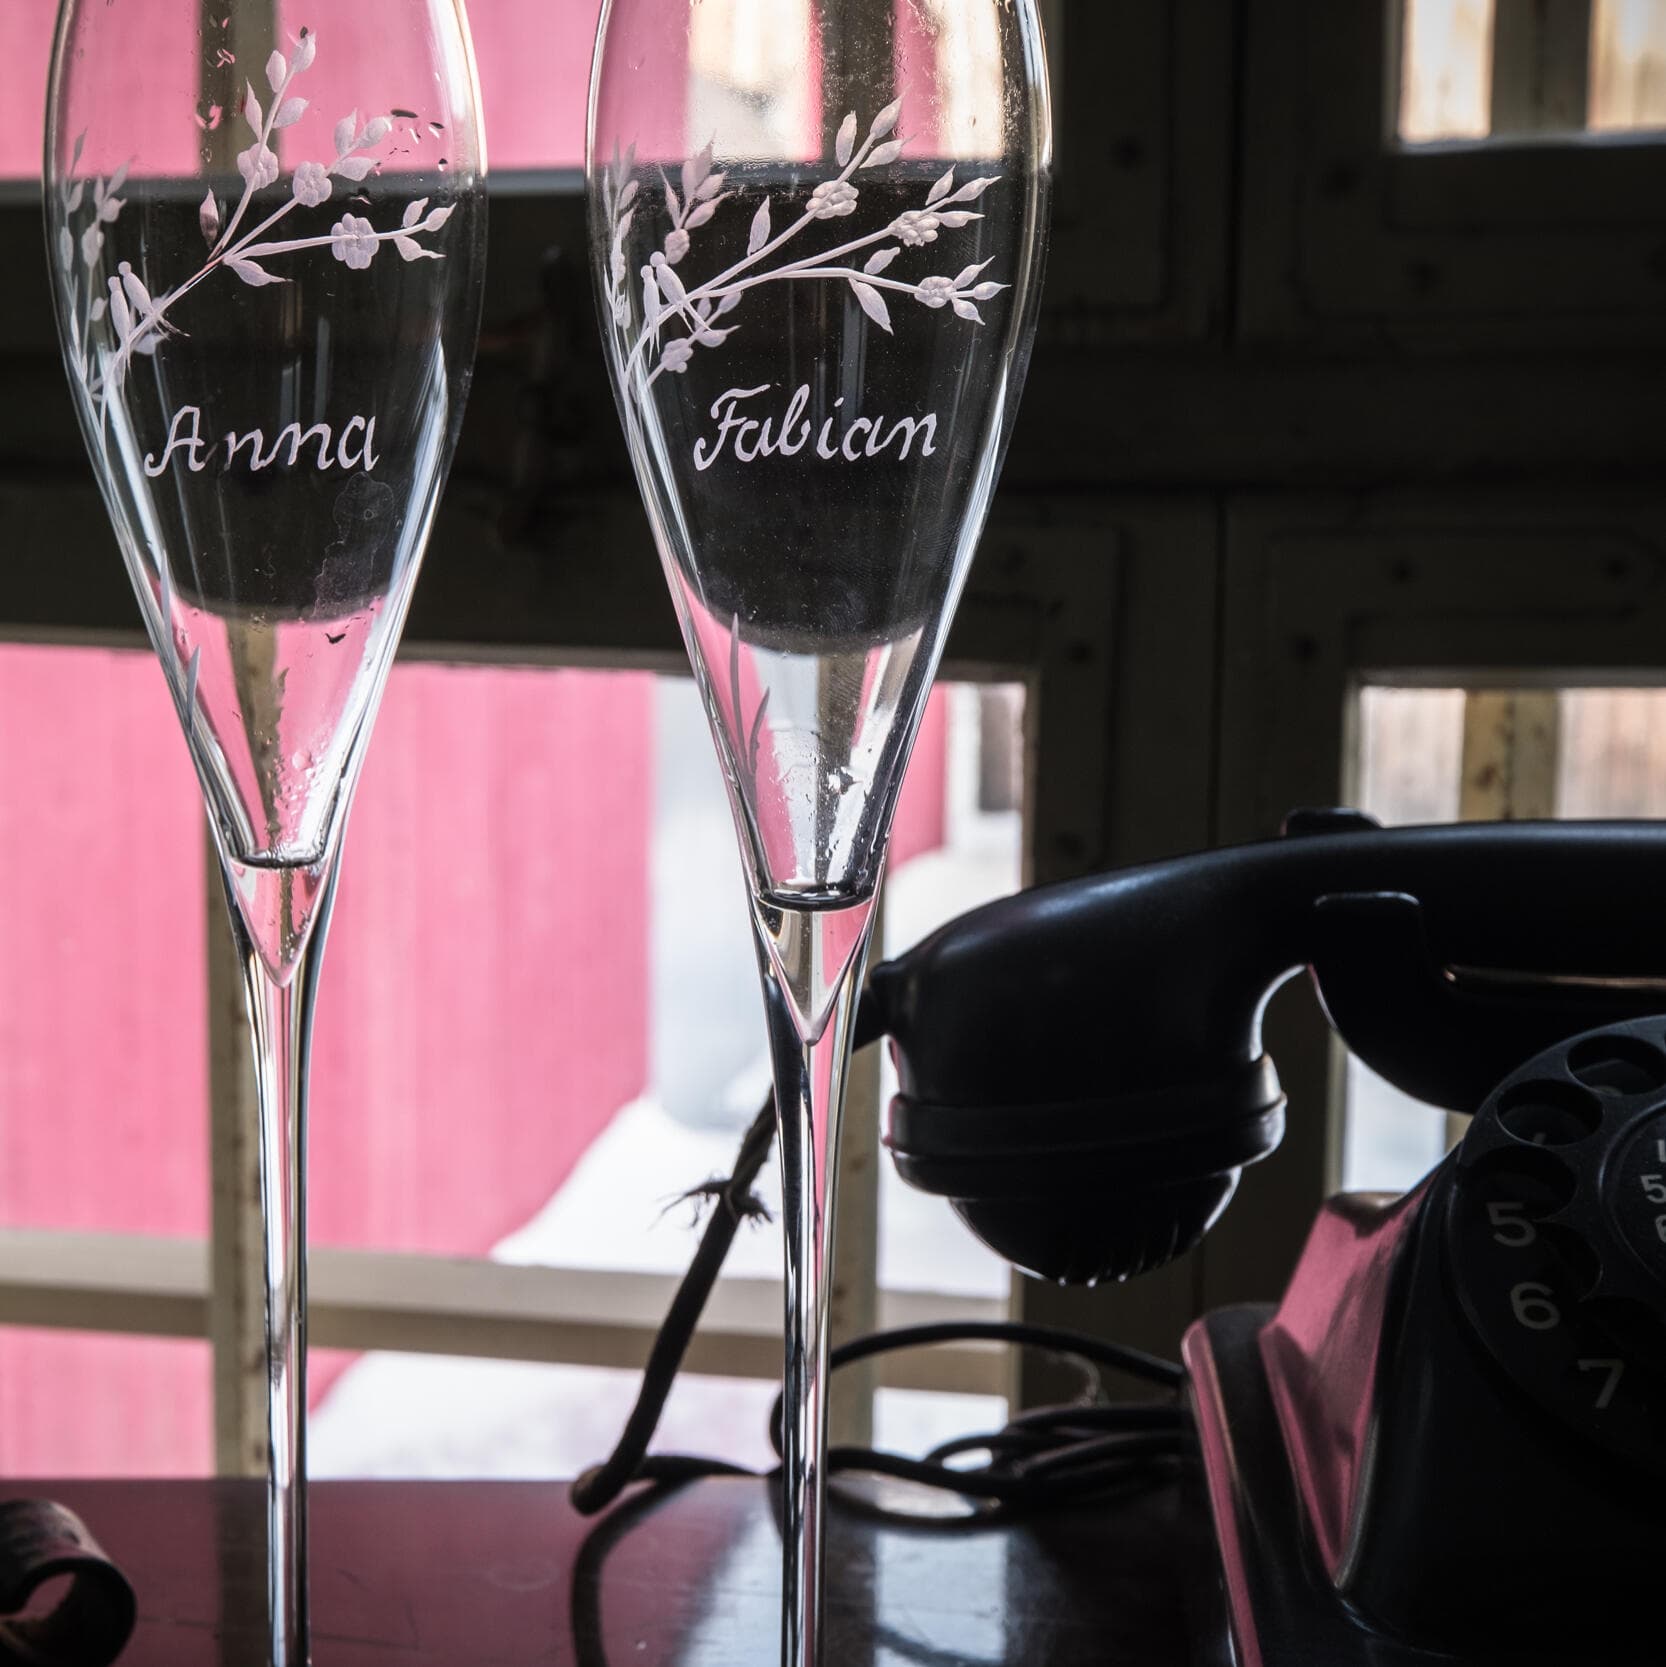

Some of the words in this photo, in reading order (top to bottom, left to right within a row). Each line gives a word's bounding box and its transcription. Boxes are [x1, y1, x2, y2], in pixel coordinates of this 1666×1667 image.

[144, 405, 379, 477] Anna
[693, 384, 937, 471] Fabian
[1486, 1201, 1537, 1247] 5
[1509, 1281, 1561, 1330] 6
[1577, 1359, 1625, 1409] 7
